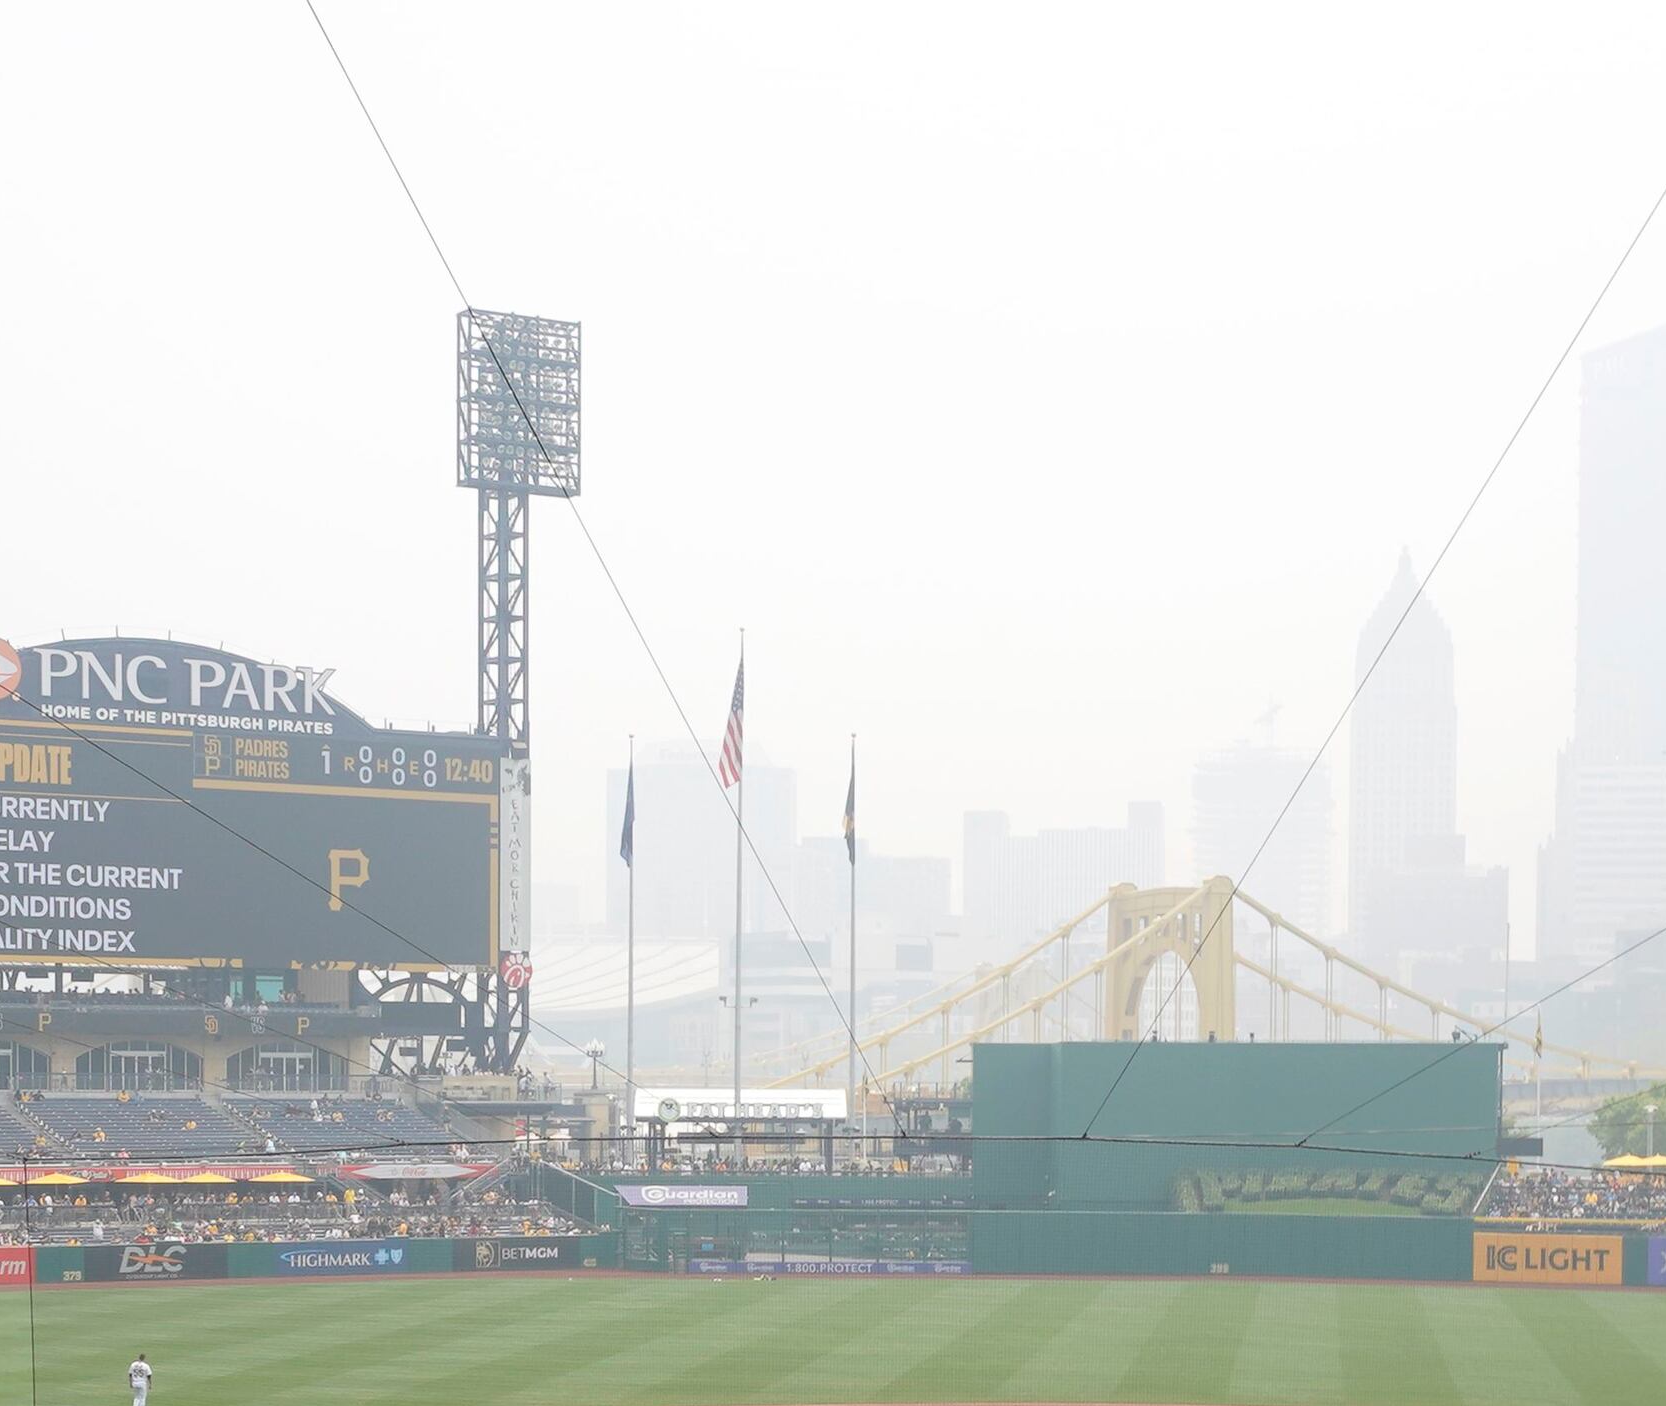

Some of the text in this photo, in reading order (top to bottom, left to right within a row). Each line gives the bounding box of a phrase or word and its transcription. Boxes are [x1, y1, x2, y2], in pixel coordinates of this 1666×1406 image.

[34, 648, 337, 716] PNC PARK
[42, 704, 333, 735] HOME OF THE PITTSBURGH PIRATES
[235, 738, 289, 758] PADRES
[359, 746, 437, 768] 0 0 0
[235, 758, 290, 780] PIRATES
[343, 757, 354, 771] R
[376, 761, 389, 773] H
[409, 763, 419, 776] E
[445, 758, 493, 784] 12:40
[359, 766, 437, 787] 0 0 0
[14, 862, 61, 886] THE
[66, 864, 182, 890] CURRENT
[58, 930, 136, 952] INDEX
[38, 1012, 52, 1033] P
[297, 1016, 310, 1035] P
[687, 1102, 823, 1118] FAT HEAD'S
[641, 1186, 739, 1203] Guardian
[290, 1252, 370, 1268] HIGHMARK
[501, 1246, 558, 1260] BETMGM
[1525, 1247, 1610, 1271] LIGHT
